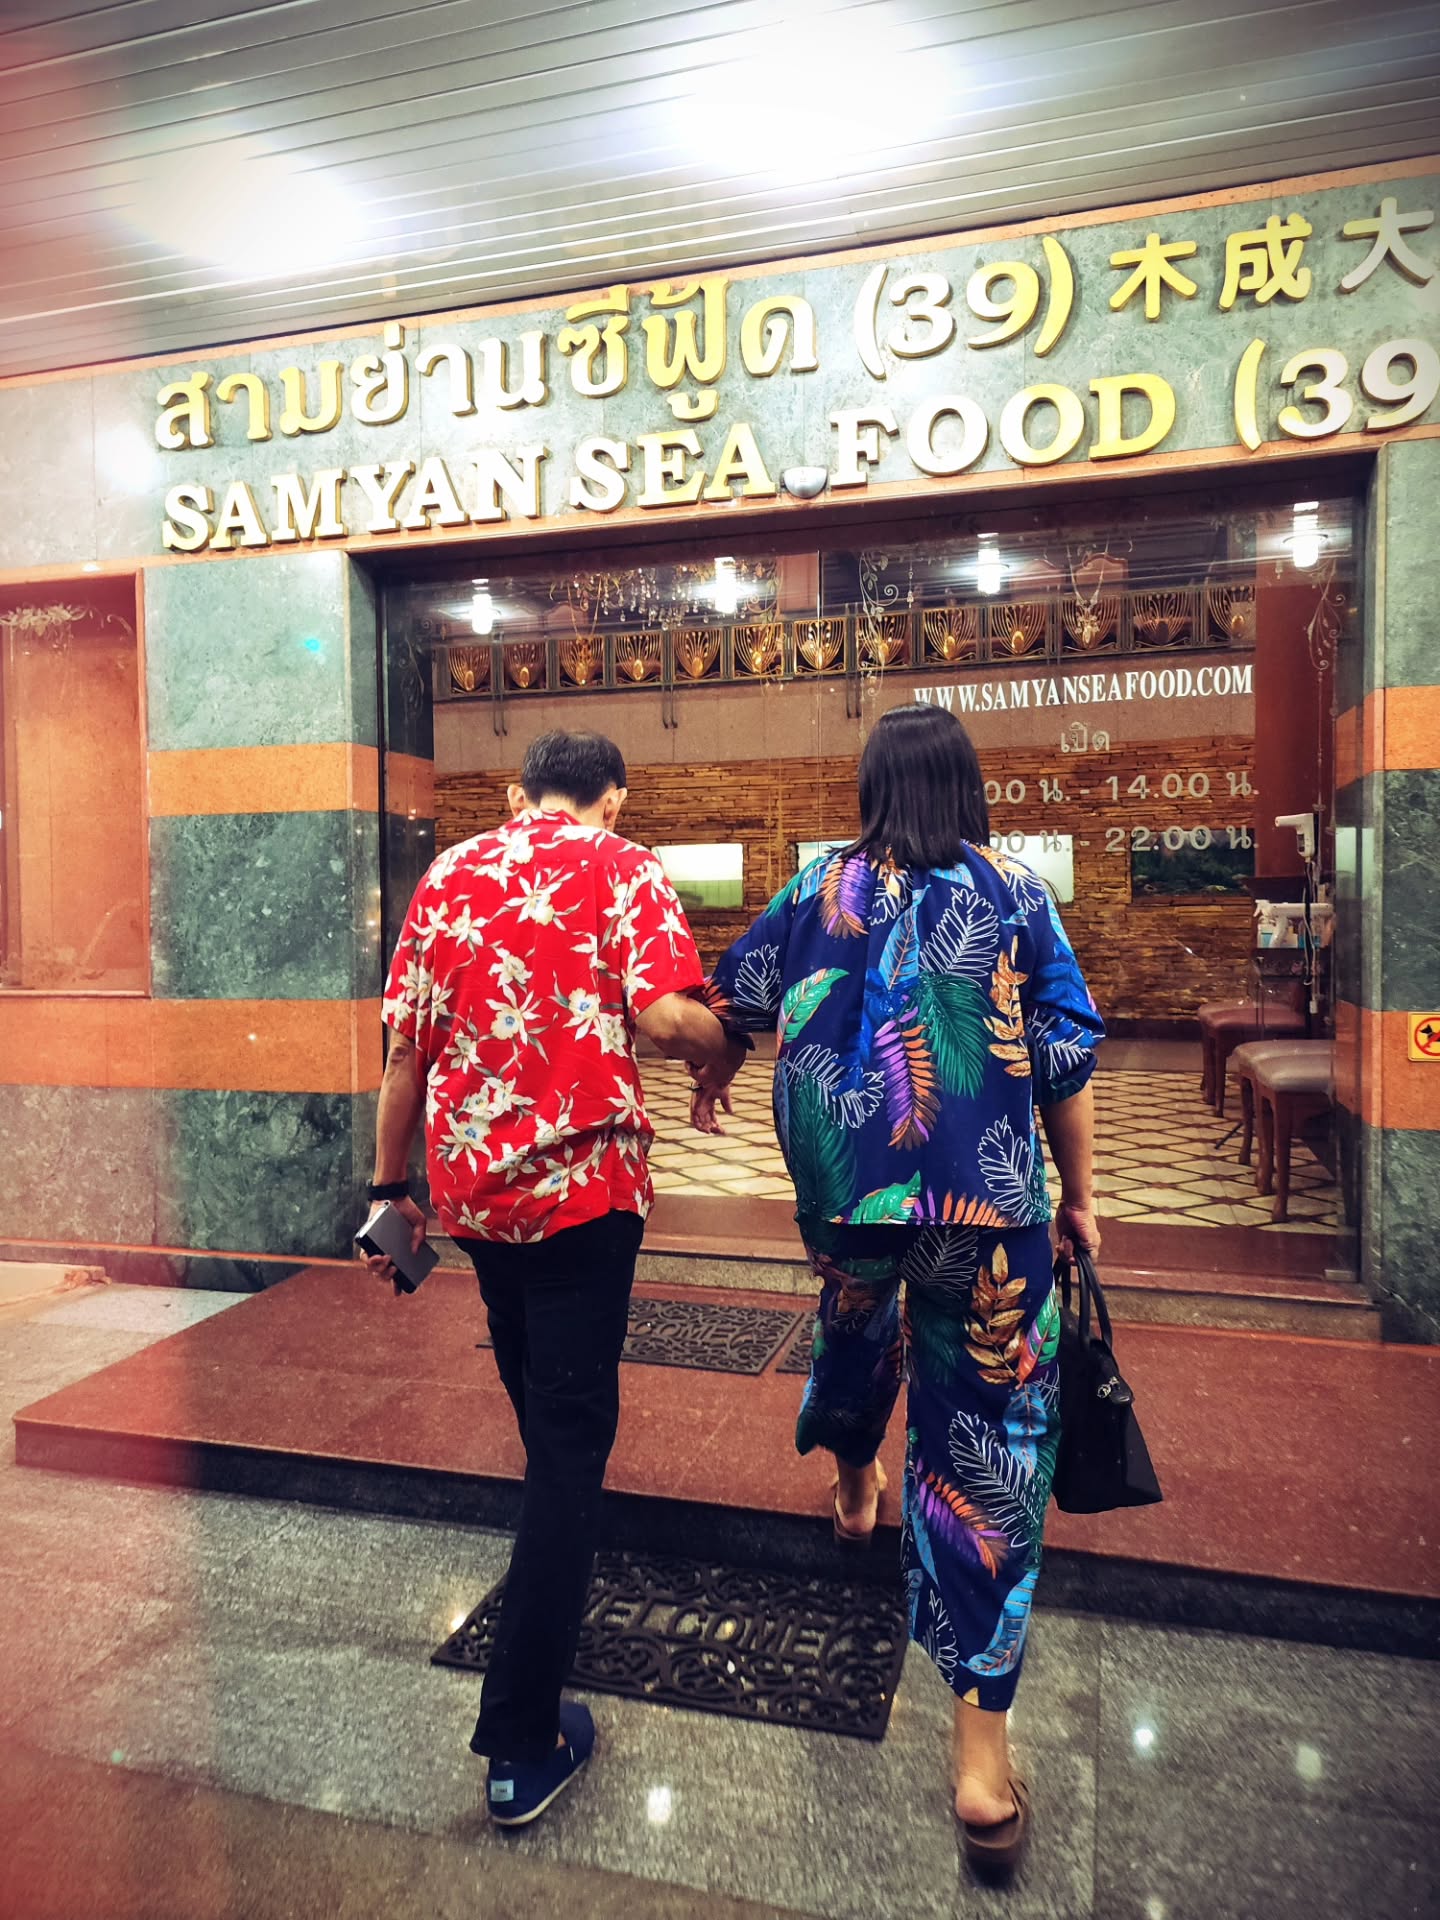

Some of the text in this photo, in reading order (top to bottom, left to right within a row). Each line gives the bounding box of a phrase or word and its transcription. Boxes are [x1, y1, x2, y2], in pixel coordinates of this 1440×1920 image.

[155, 236, 1075, 450] สามย่านซีฟู้ด (39)
[162, 446, 549, 553] SAMYAN
[569, 422, 778, 514] SEA
[829, 372, 1176, 488] FOOD
[914, 664, 1254, 713] WWW.SAMYANSEAFOOD.COM
[1060, 721, 1110, 753] เปิด
[1105, 773, 1210, 801] 14.00
[1105, 825, 1212, 852] 22.00
